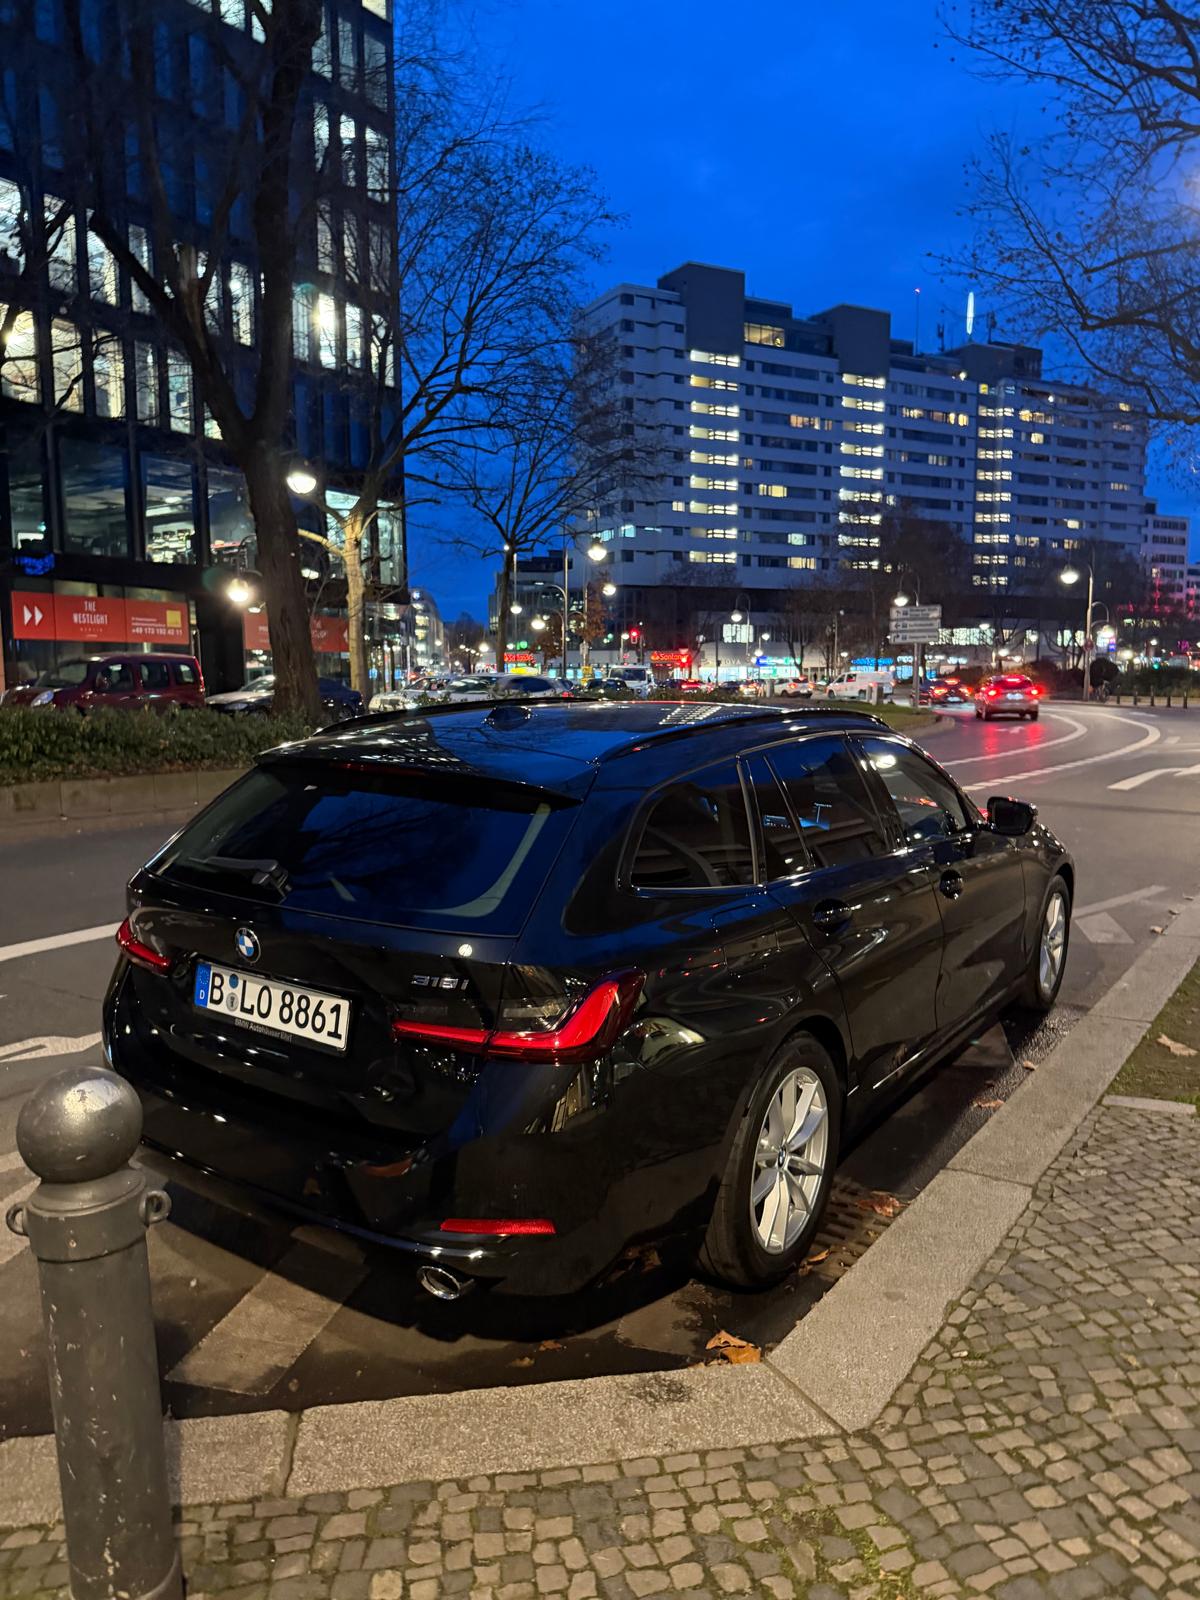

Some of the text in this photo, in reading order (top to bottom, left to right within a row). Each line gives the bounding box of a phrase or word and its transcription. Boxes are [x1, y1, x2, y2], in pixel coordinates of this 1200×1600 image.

[84, 600, 96, 612] THE
[411, 974, 470, 990] 318i
[209, 972, 342, 1040] B LO 8861
